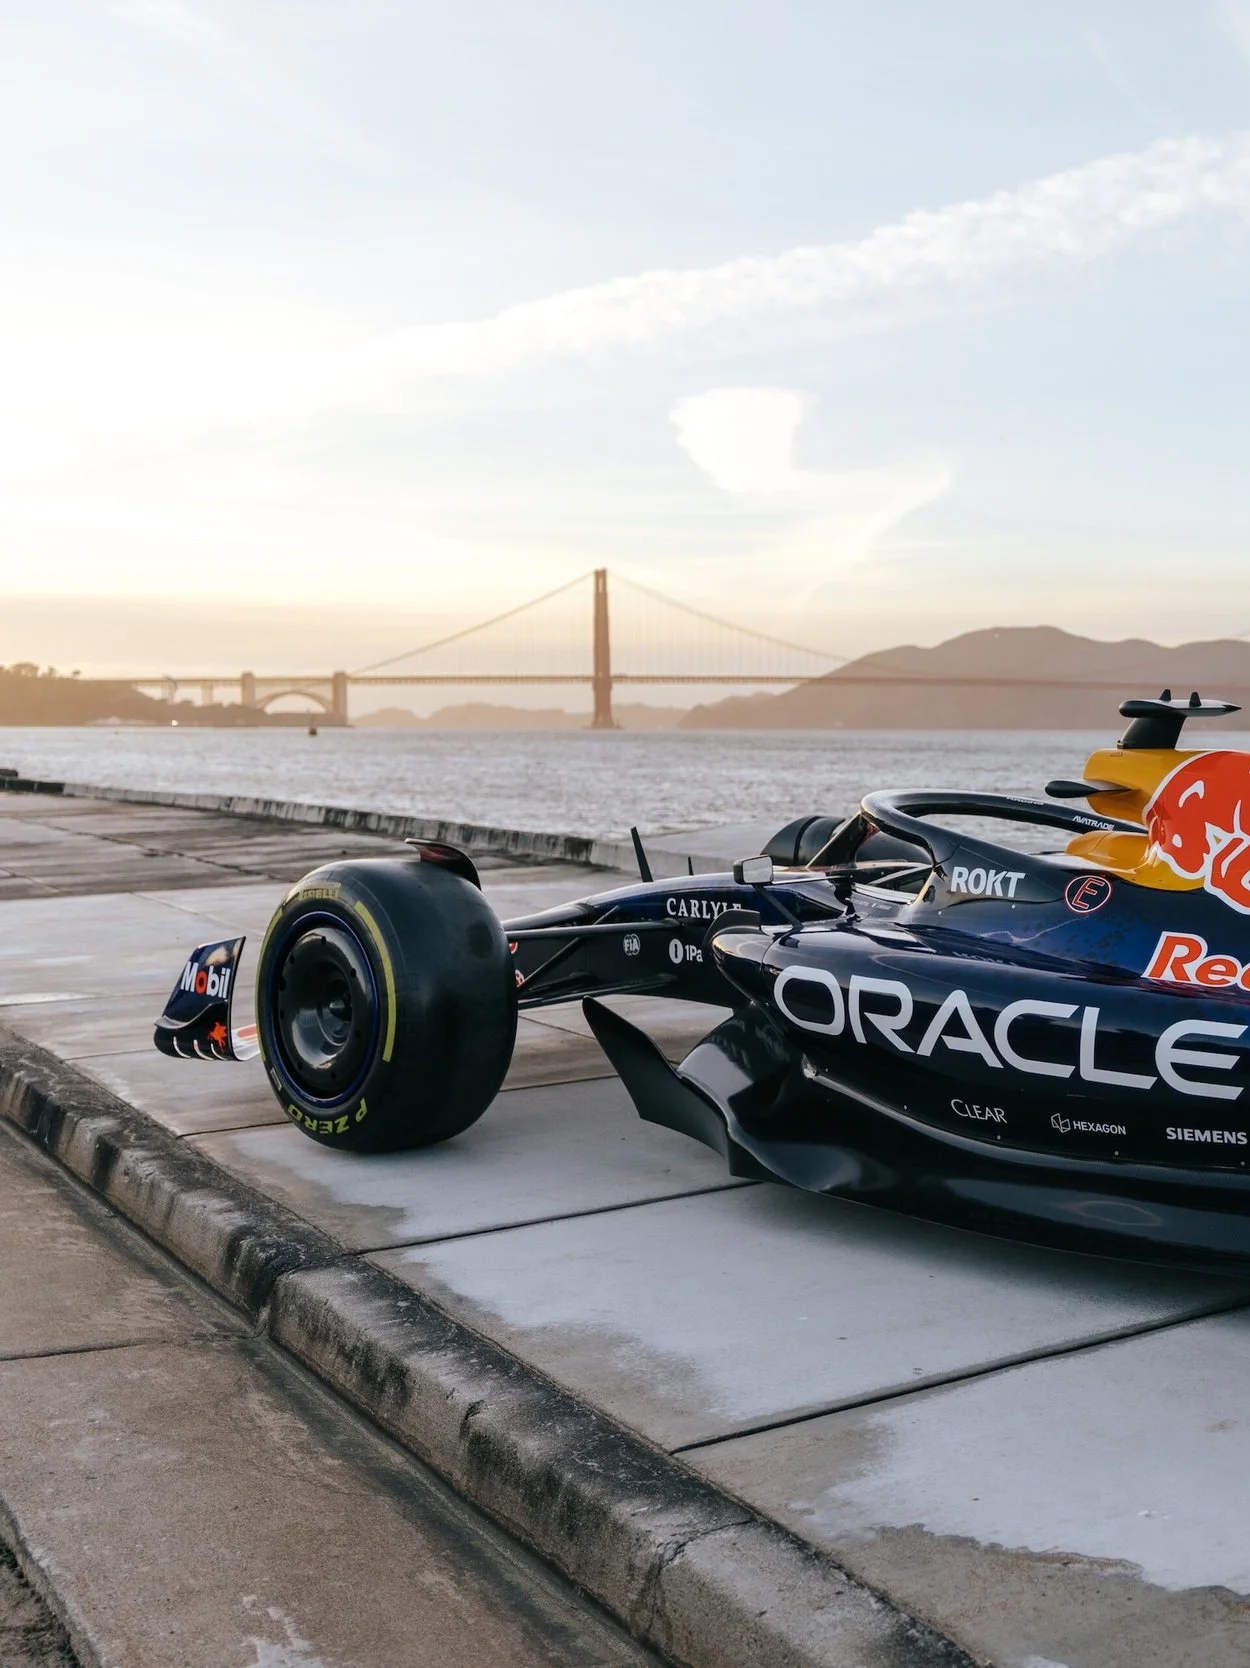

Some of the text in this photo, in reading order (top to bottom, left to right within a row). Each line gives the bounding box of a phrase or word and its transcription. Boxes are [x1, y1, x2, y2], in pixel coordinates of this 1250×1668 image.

[1072, 815, 1115, 831] AVATRADE
[951, 866, 1026, 898] ROKT
[623, 936, 640, 953] FIA
[180, 961, 231, 999] Mobil
[773, 964, 1248, 1101] ORACLE
[287, 1097, 368, 1133] P ZERO
[951, 1099, 1008, 1124] CLEAR
[1073, 1120, 1127, 1135] HEXAGON
[1166, 1127, 1248, 1145] SIEMENS
